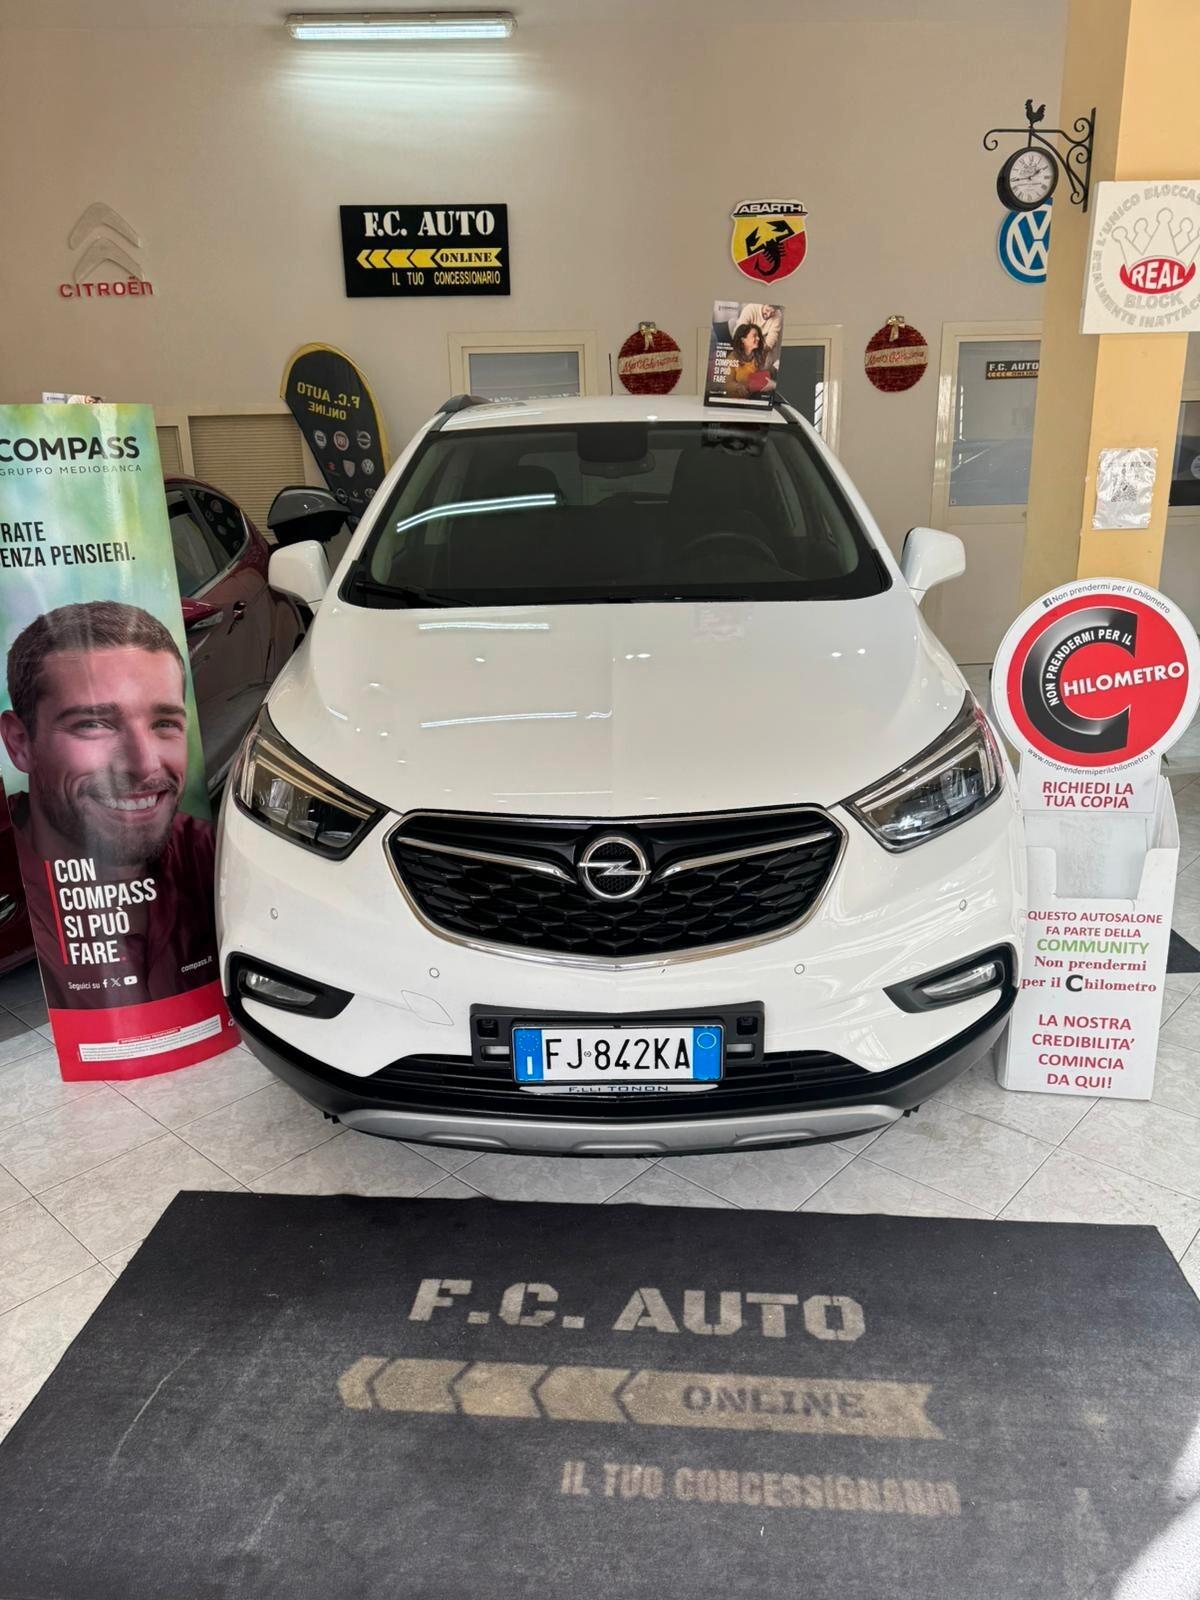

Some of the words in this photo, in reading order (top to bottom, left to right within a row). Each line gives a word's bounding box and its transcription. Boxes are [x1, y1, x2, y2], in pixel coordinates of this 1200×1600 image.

[739, 203, 801, 213] ABARTH
[363, 210, 407, 237] F.C.
[417, 210, 495, 236] AUTO
[440, 252, 492, 263] ONLINE
[392, 272, 400, 285] IL
[407, 272, 424, 285] TUO
[434, 271, 501, 285] CONCESSIONARIO
[1131, 261, 1185, 289] REAL
[1124, 291, 1185, 310] BLOCK
[989, 363, 1007, 371] F.C.
[1011, 362, 1039, 370] AUTO
[0, 436, 140, 462] COMPASS
[60, 464, 142, 474] MEDIOBANCA
[0, 521, 46, 543] RATE
[50, 541, 136, 565] PENSIERI.
[1052, 592, 1069, 603] Non
[1069, 582, 1111, 598] prendermi
[1111, 584, 1126, 592] per
[1127, 585, 1133, 593] il
[1132, 587, 1171, 614] Chilometro
[1098, 629, 1120, 641] PER
[1121, 632, 1133, 646] IL
[1045, 631, 1095, 680] PRENDERMI
[1045, 683, 1060, 707] NON
[1042, 781, 1110, 795] RICHIEDI
[1113, 782, 1134, 795] LA
[1044, 795, 1076, 808] TUA
[1080, 795, 1130, 809] COPIA
[54, 858, 97, 883] CON
[59, 878, 157, 911] COMPASS
[64, 915, 84, 938] SI
[89, 907, 130, 937] PUÒ
[1027, 910, 1077, 922] QUESTO
[1080, 911, 1163, 924] AUTOSALONE
[1046, 926, 1061, 936] FA
[1063, 927, 1101, 937] PARTE
[1104, 928, 1141, 938] DELLA
[1036, 938, 1150, 955] COMMUNITY
[180, 955, 213, 973] compass.it
[1034, 956, 1064, 969] Non
[1068, 959, 1147, 972] prendermi
[68, 981, 91, 991] Seguici
[92, 982, 101, 990] su
[1021, 978, 1047, 990] per
[1049, 976, 1061, 988] il
[1065, 974, 1157, 993] Chilometro
[1038, 1014, 1058, 1027] LA
[1064, 1016, 1132, 1031] NOSTRA
[1032, 1033, 1135, 1051] CREDIBILITA'
[1038, 1053, 1124, 1070] COMINCIA
[1047, 1073, 1070, 1087] DA
[1074, 1074, 1112, 1089] QUI!
[408, 1278, 585, 1329] F.C.
[612, 1286, 866, 1342] AUTO
[683, 1384, 867, 1419] ONLINE
[561, 1460, 591, 1496] IL
[602, 1462, 664, 1499] TUO
